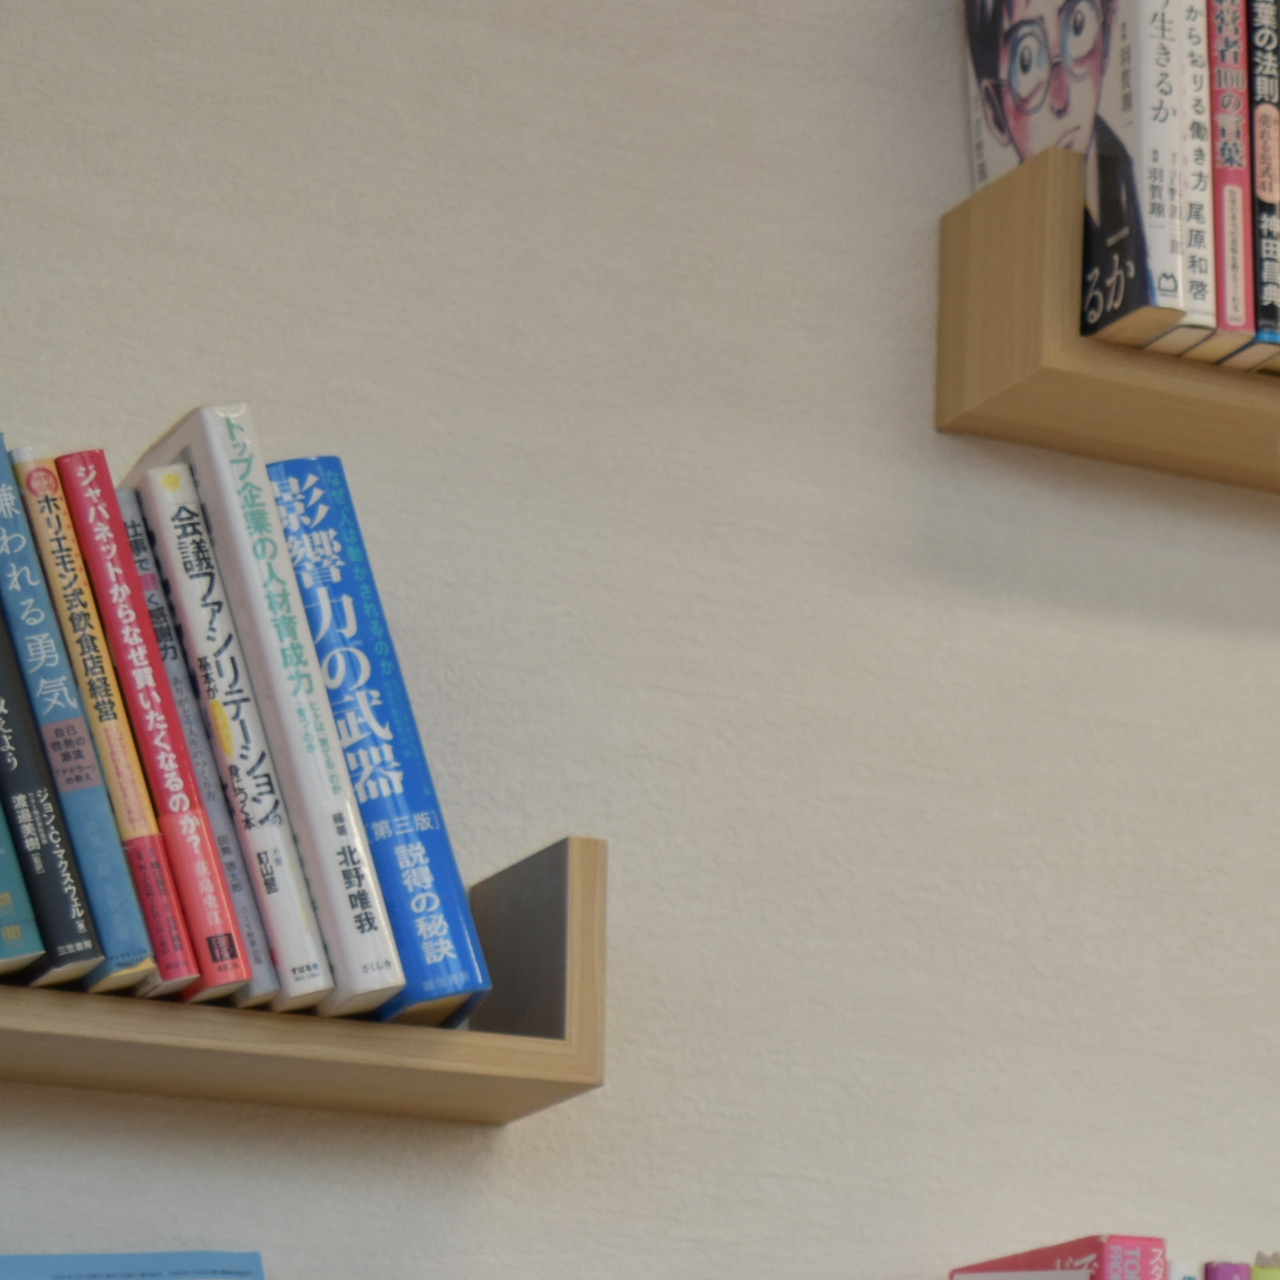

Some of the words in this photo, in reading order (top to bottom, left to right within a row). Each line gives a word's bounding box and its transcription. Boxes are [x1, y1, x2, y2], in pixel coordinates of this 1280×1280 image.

[1213, 0, 1246, 169] 営者100の言葉
[1187, 202, 1209, 301] 尾原和啓
[38, 494, 118, 723] ホリエモン式飲食店経営
[225, 417, 316, 699] トップ企業の人材育成力
[270, 473, 405, 806] 影響力の武器
[171, 504, 280, 827] 会議ファシリテーション
[336, 844, 379, 935] 北野唯我
[393, 841, 459, 967] 説得の秘訣
